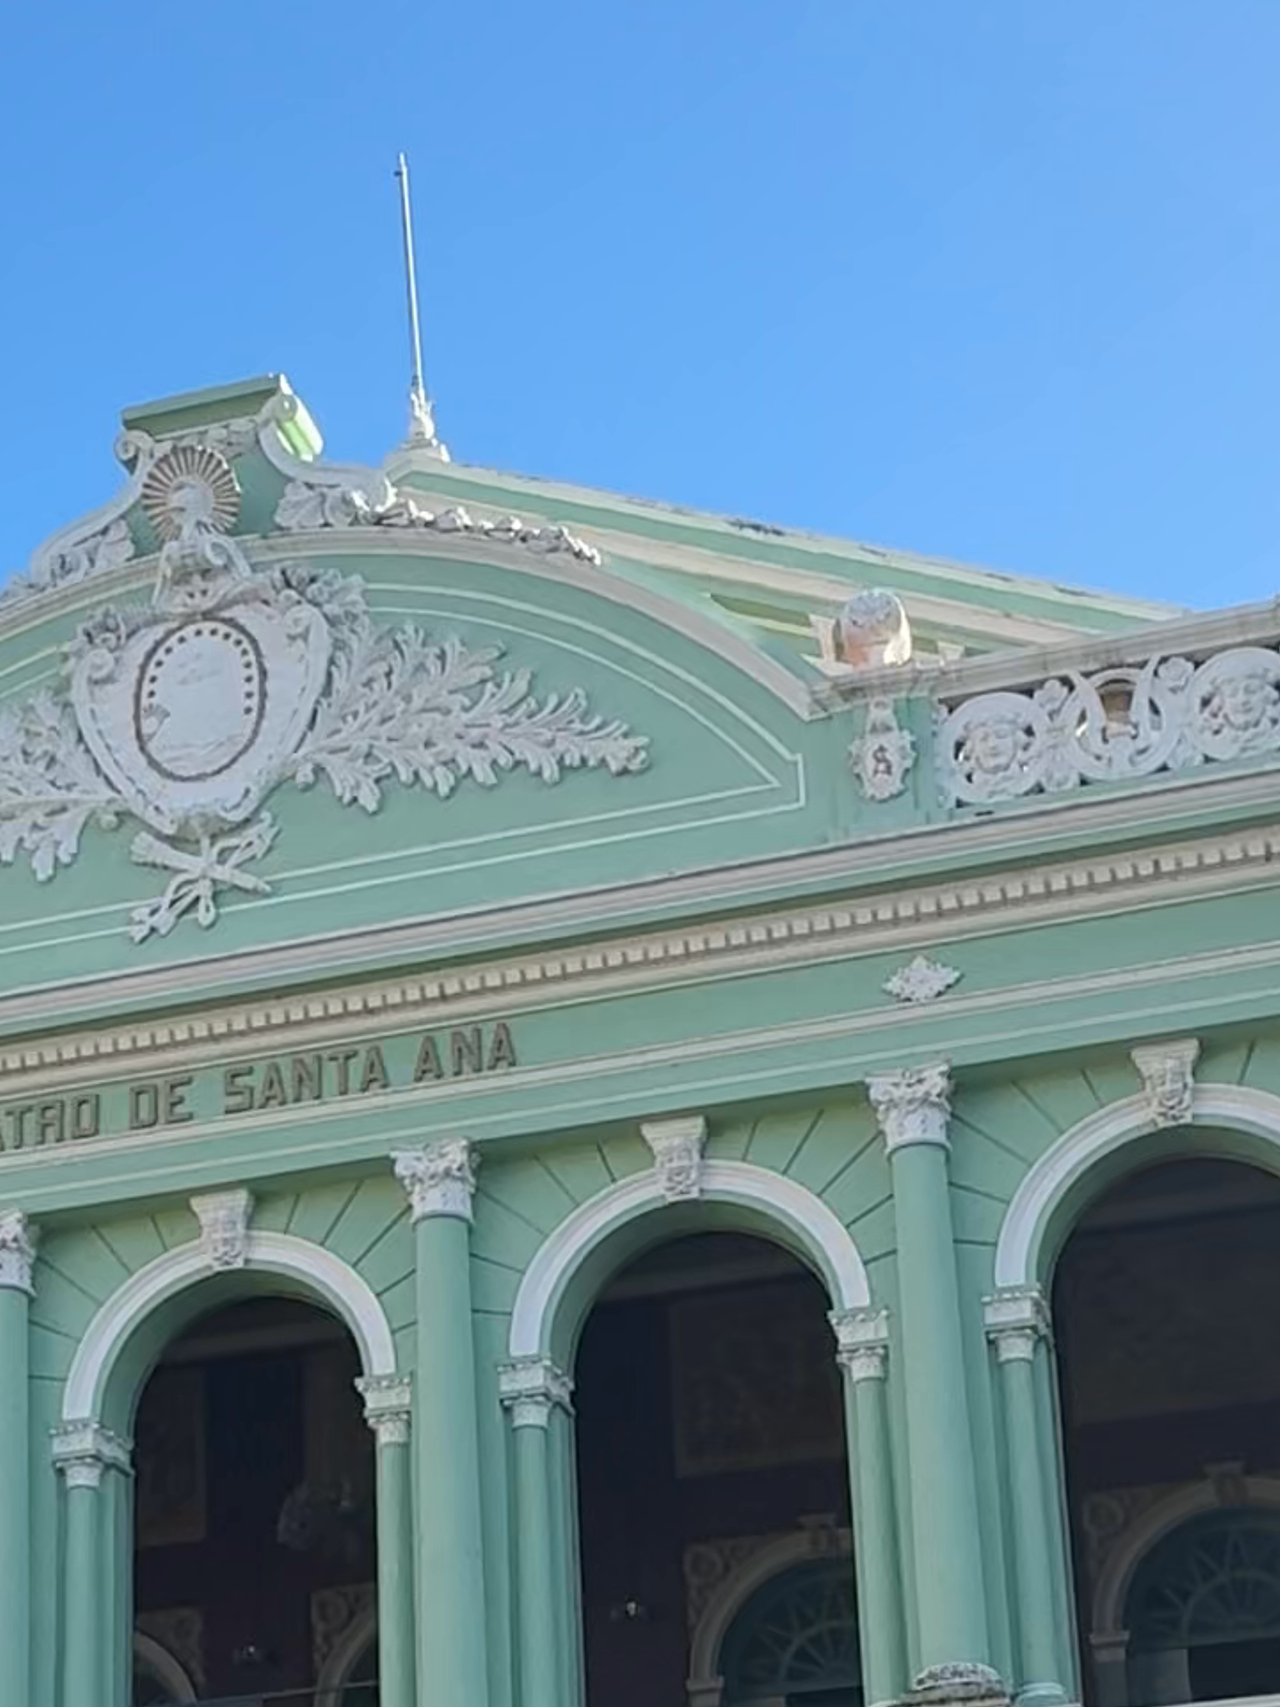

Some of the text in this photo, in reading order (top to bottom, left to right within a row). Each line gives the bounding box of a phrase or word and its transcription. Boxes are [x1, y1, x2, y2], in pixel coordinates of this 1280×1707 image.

[129, 1075, 195, 1130] DE
[224, 1045, 390, 1115] SANTA
[413, 1022, 517, 1083] ANA
